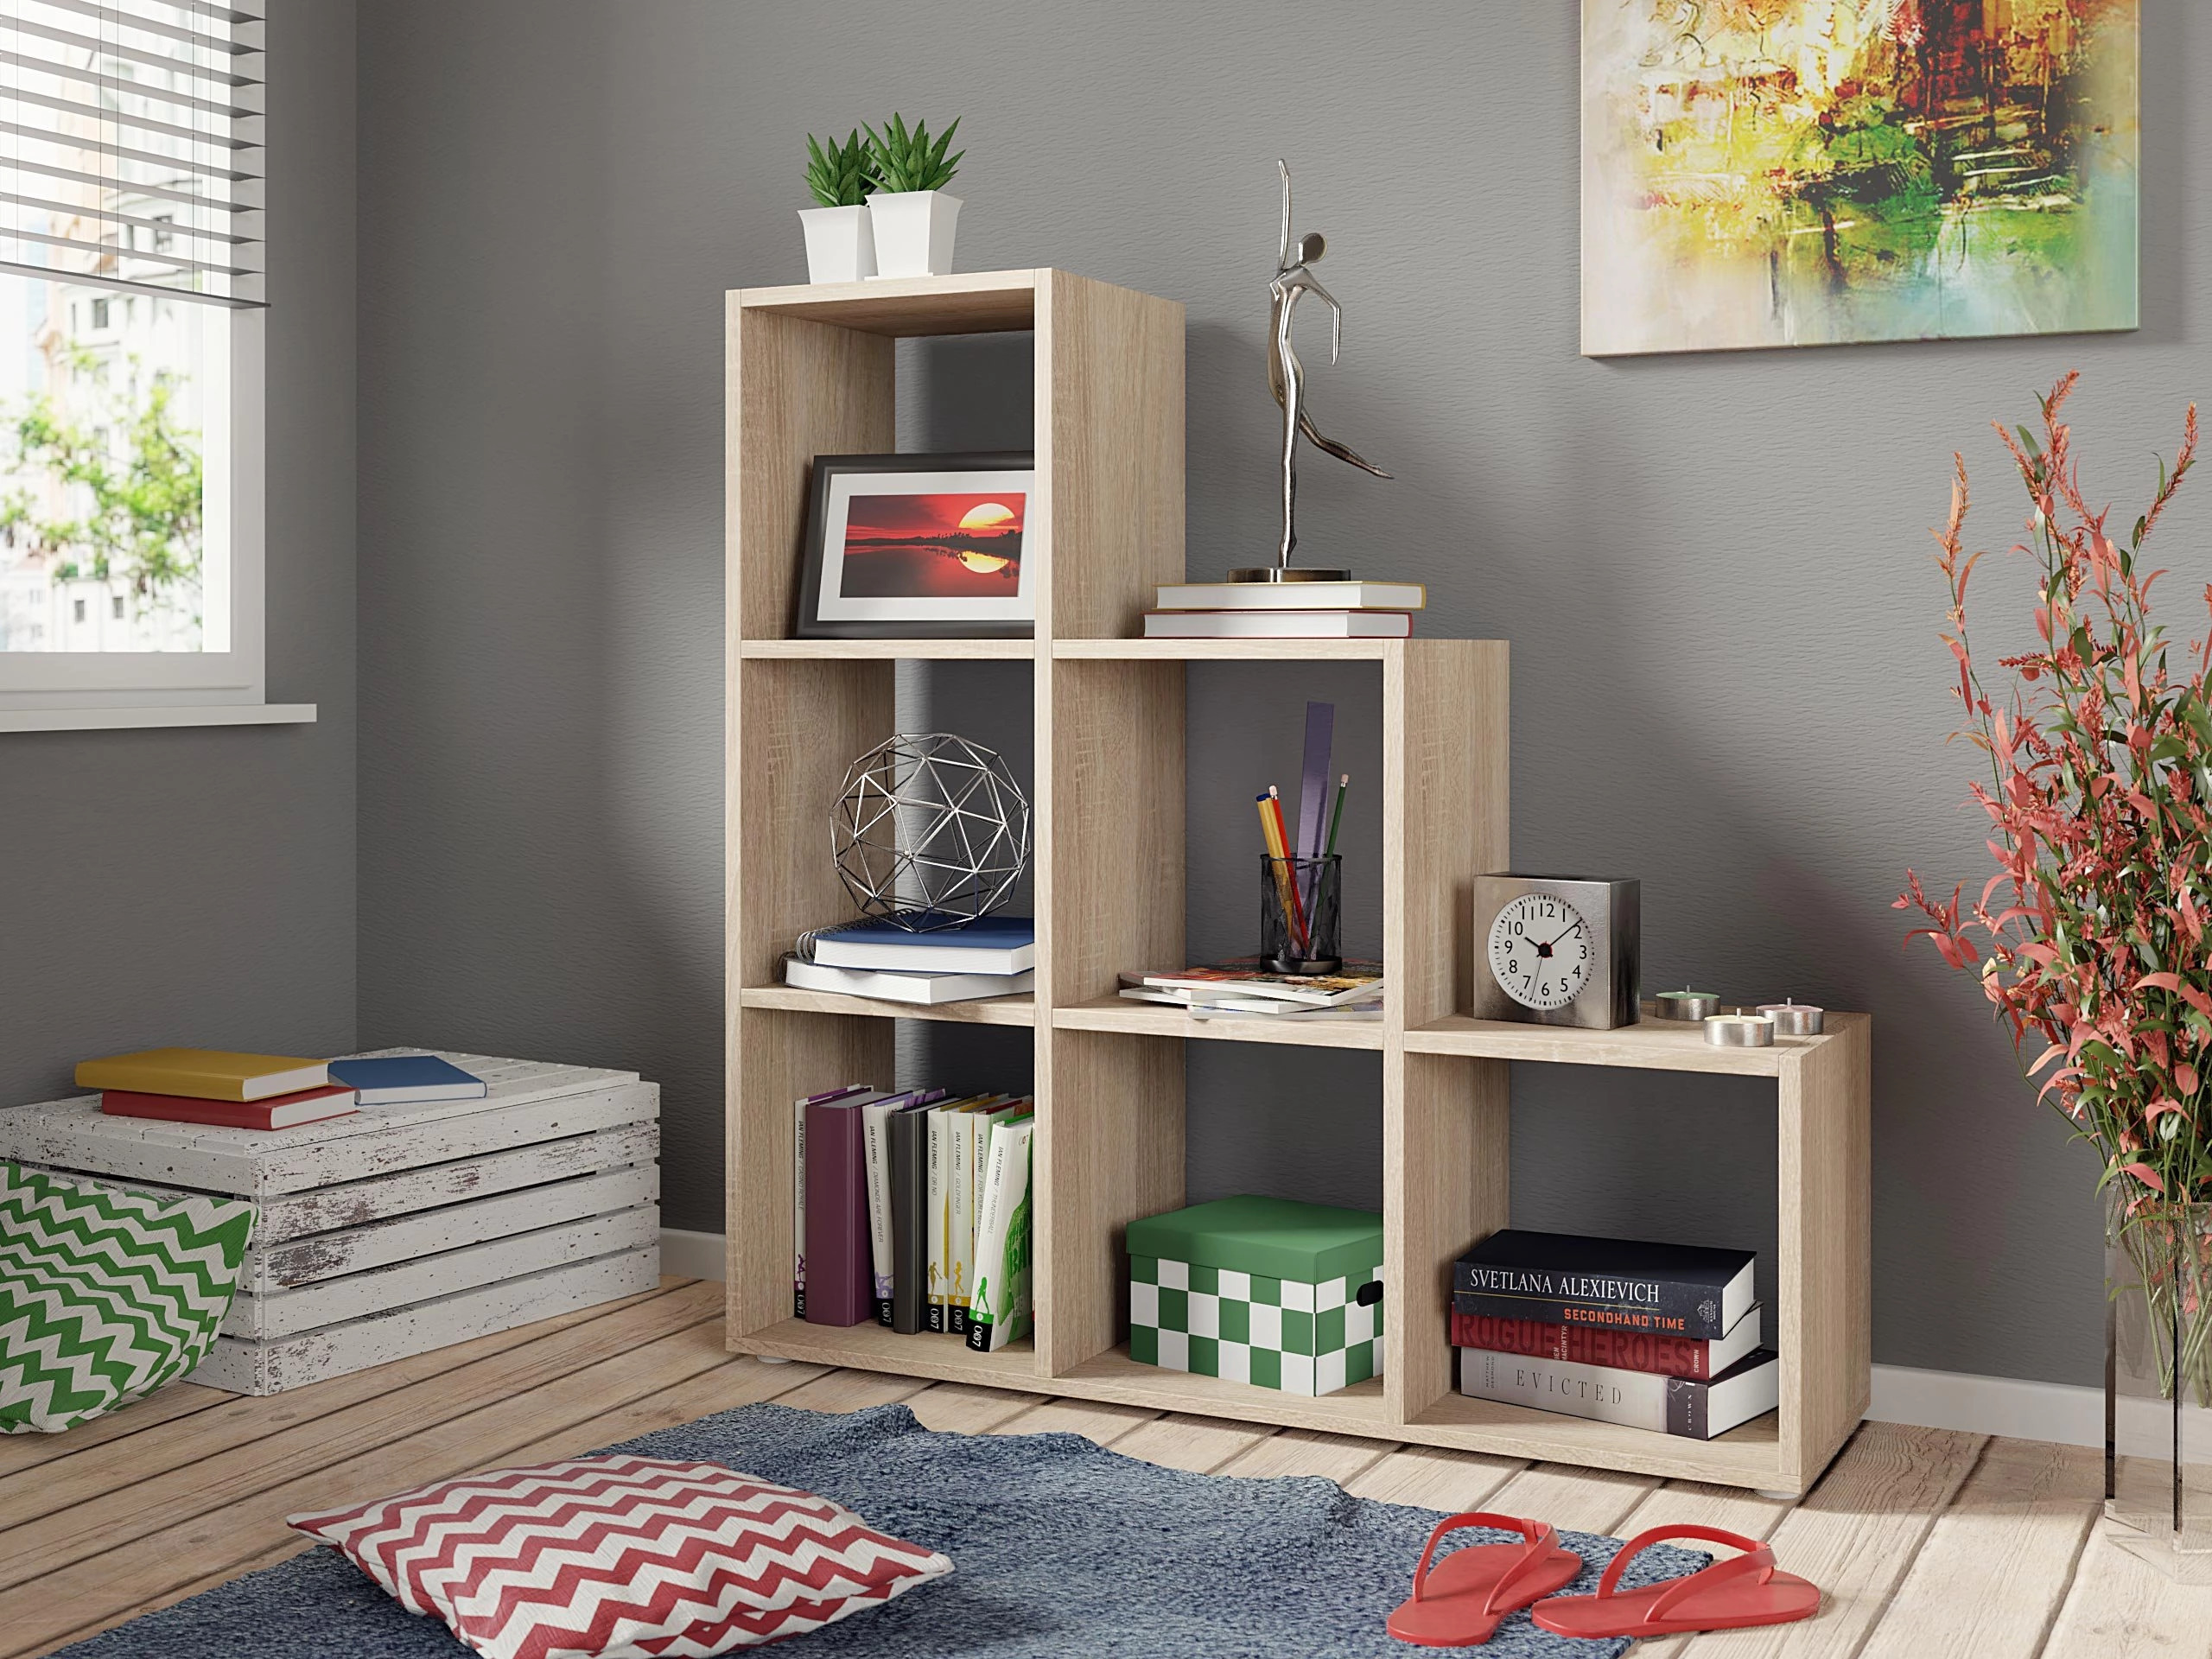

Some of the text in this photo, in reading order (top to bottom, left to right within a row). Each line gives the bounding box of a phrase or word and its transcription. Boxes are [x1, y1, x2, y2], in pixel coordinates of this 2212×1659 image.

[1522, 906, 1535, 921] 11
[1540, 903, 1555, 918] 12
[1562, 908, 1566, 922] 1
[1508, 921, 1523, 936] 10
[1573, 925, 1582, 939] 2
[1504, 940, 1513, 954] 9
[1580, 945, 1587, 959] 3
[1509, 959, 1518, 974] 8
[1572, 965, 1581, 979] 4
[1522, 975, 1531, 989] 7
[1541, 982, 1550, 996] 6
[1560, 978, 1568, 992] 5
[994, 1159, 1002, 1186] FLEMING
[932, 1177, 938, 1186] DR
[932, 1186, 938, 1196] NO
[1470, 1268, 1660, 1303] SVETLANA ALEXIEVICH
[881, 1302, 892, 1323] 007
[931, 1308, 939, 1330] 007
[1564, 1308, 1685, 1331] SECONDHAND TIME
[972, 1325, 983, 1348] 007
[1459, 1313, 1692, 1377] ROGUE HEROES
[1516, 1370, 1621, 1404] EVICTED
